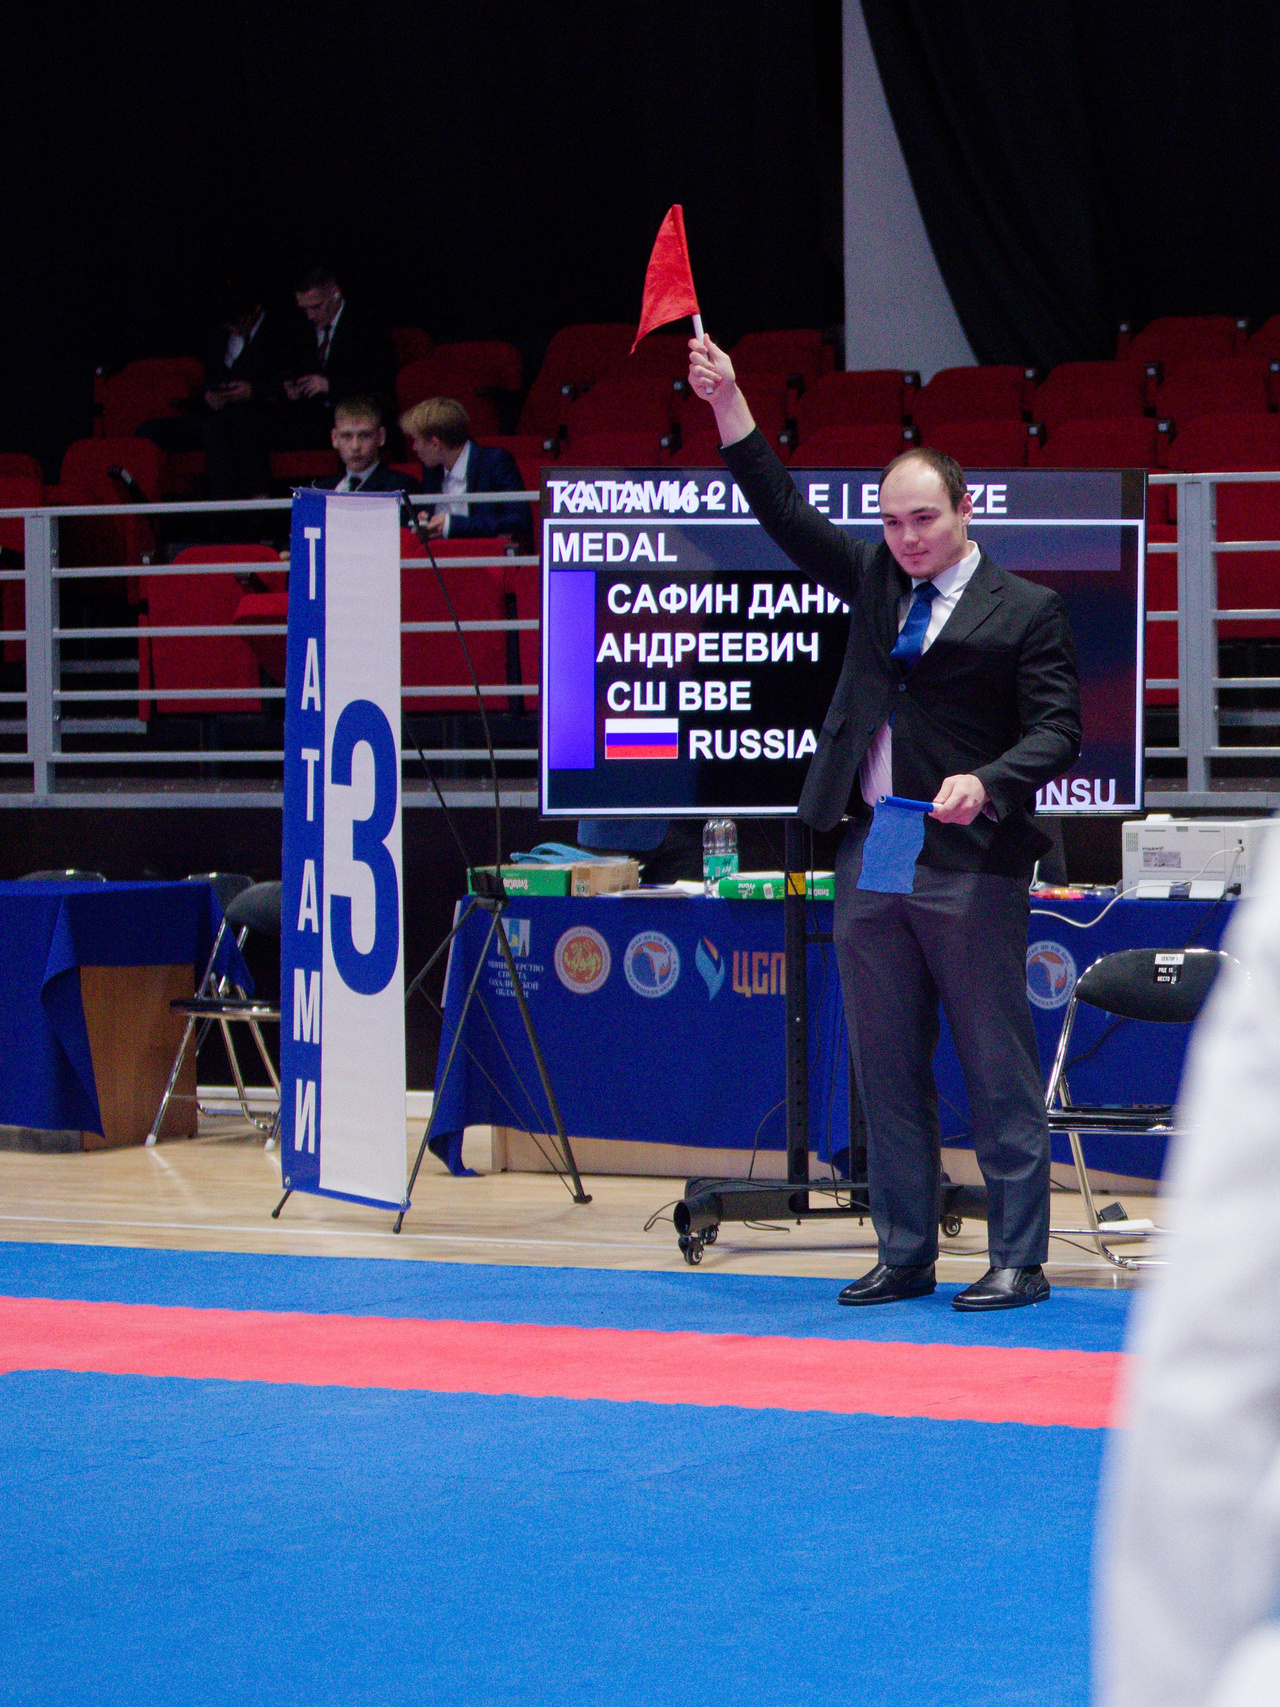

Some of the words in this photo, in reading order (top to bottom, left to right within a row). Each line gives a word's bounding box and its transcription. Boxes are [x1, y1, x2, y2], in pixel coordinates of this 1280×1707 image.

[552, 532, 678, 562] MEDAL
[607, 584, 739, 614] САФИН
[748, 584, 850, 619] ДАНИ
[596, 632, 819, 668] АНДРЕЕВИЧ
[607, 681, 667, 712] СШ
[689, 729, 818, 759] RUSSIA
[293, 527, 322, 1154] ТАТАМИ
[330, 699, 401, 996] 3
